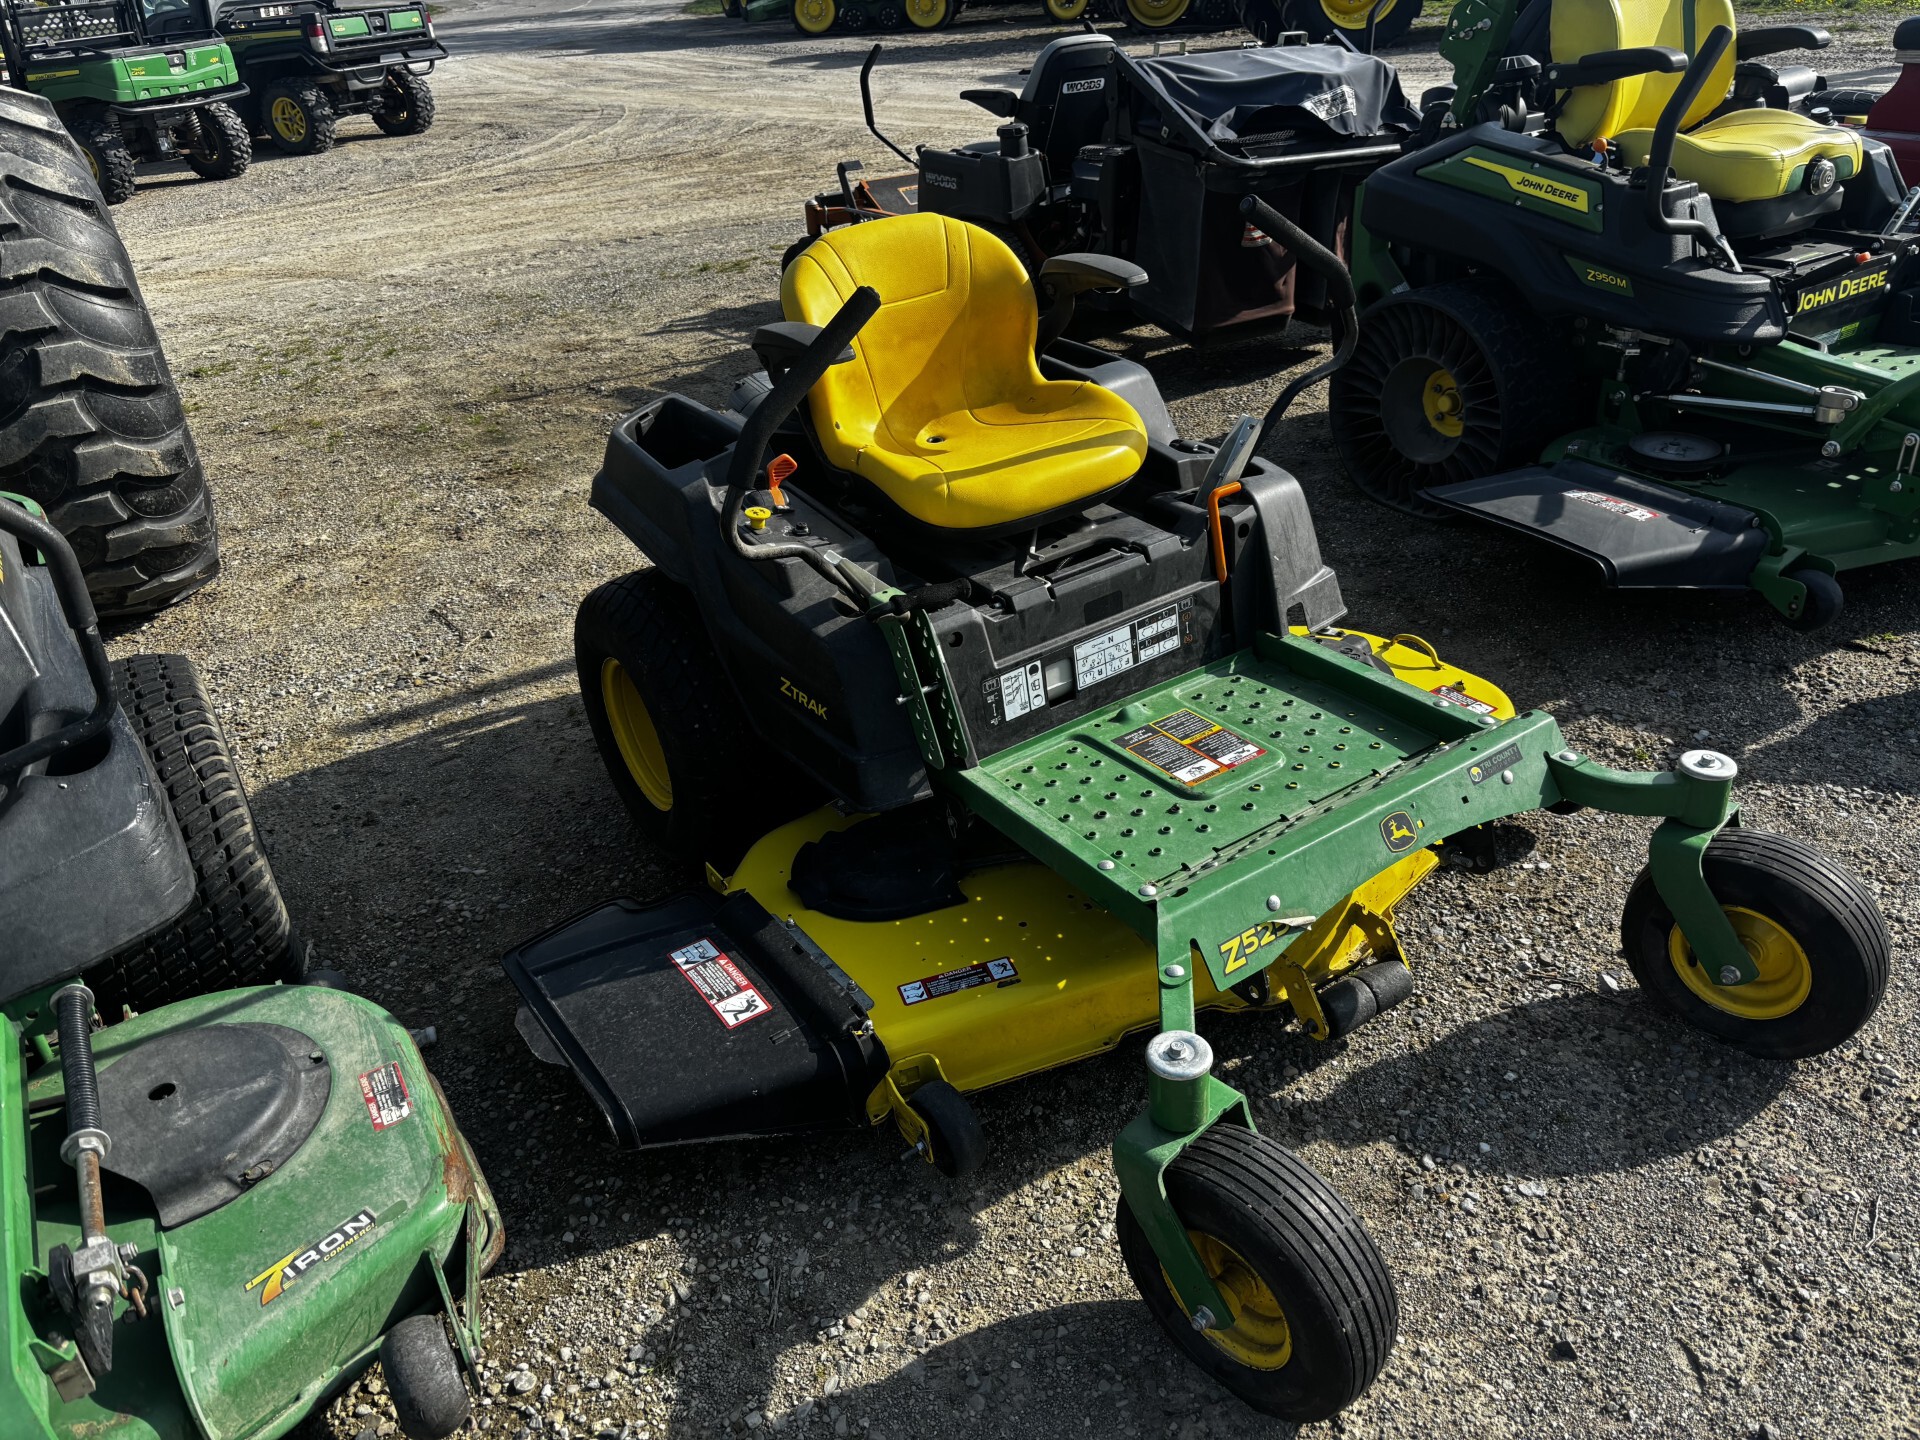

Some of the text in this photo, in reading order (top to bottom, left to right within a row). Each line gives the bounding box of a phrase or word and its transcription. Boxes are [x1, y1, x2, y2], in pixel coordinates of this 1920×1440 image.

[1066, 79, 1102, 92] WOODS
[925, 172, 957, 190] WOODS
[1516, 176, 1579, 203] JOHN DEERE
[1796, 269, 1888, 313] JOHN DEERE
[780, 676, 828, 721] ZTRAK
[1480, 746, 1518, 771] TRI COUNTY
[725, 963, 748, 987] DANGER
[943, 966, 972, 978] DANGER
